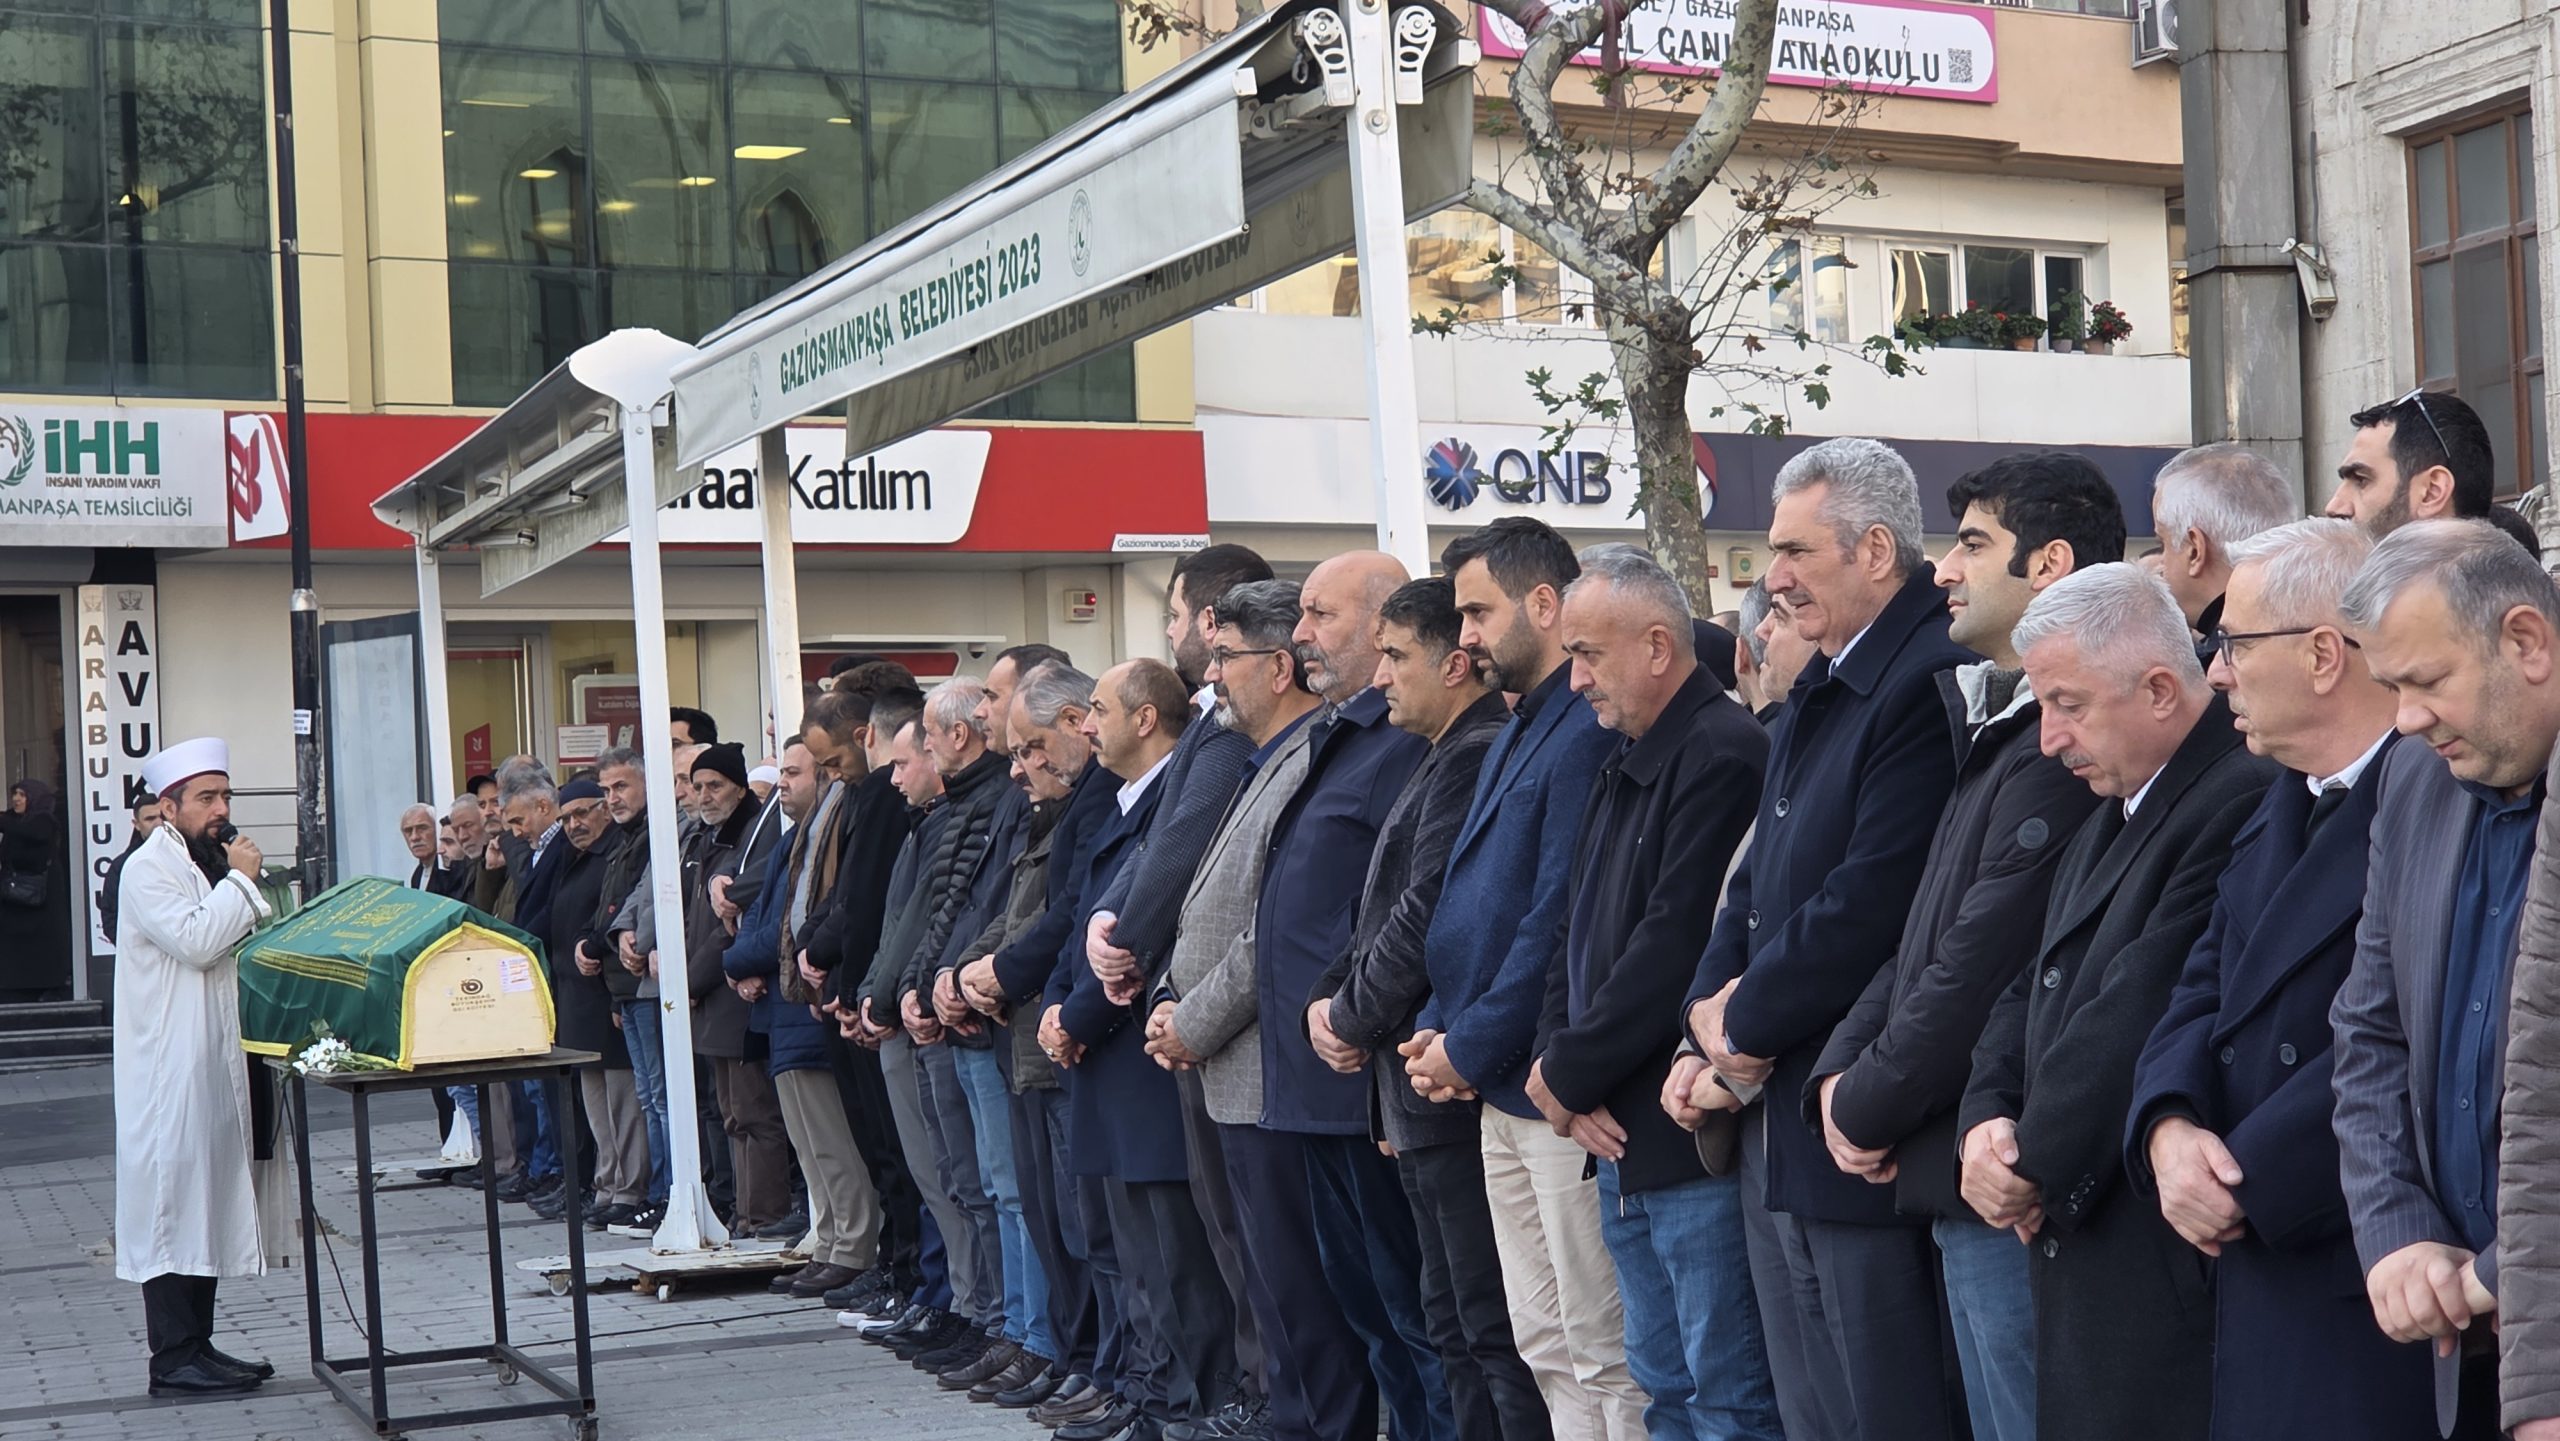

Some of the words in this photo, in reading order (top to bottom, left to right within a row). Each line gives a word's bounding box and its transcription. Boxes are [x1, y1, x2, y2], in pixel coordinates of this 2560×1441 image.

[1778, 39, 1940, 83] ANAOKULU
[780, 315, 894, 395] GAZİOSMANPAŞA
[900, 239, 992, 341] BELEDİYESİ
[998, 232, 1041, 299] 2023
[85, 476, 127, 488] YARDIM
[129, 477, 161, 489] VAKFI
[788, 455, 932, 511] Katılım
[1494, 448, 1612, 505] QNB
[0, 498, 80, 520] ANPAŞA
[85, 496, 193, 518] TEMSİLCİLİĞİ
